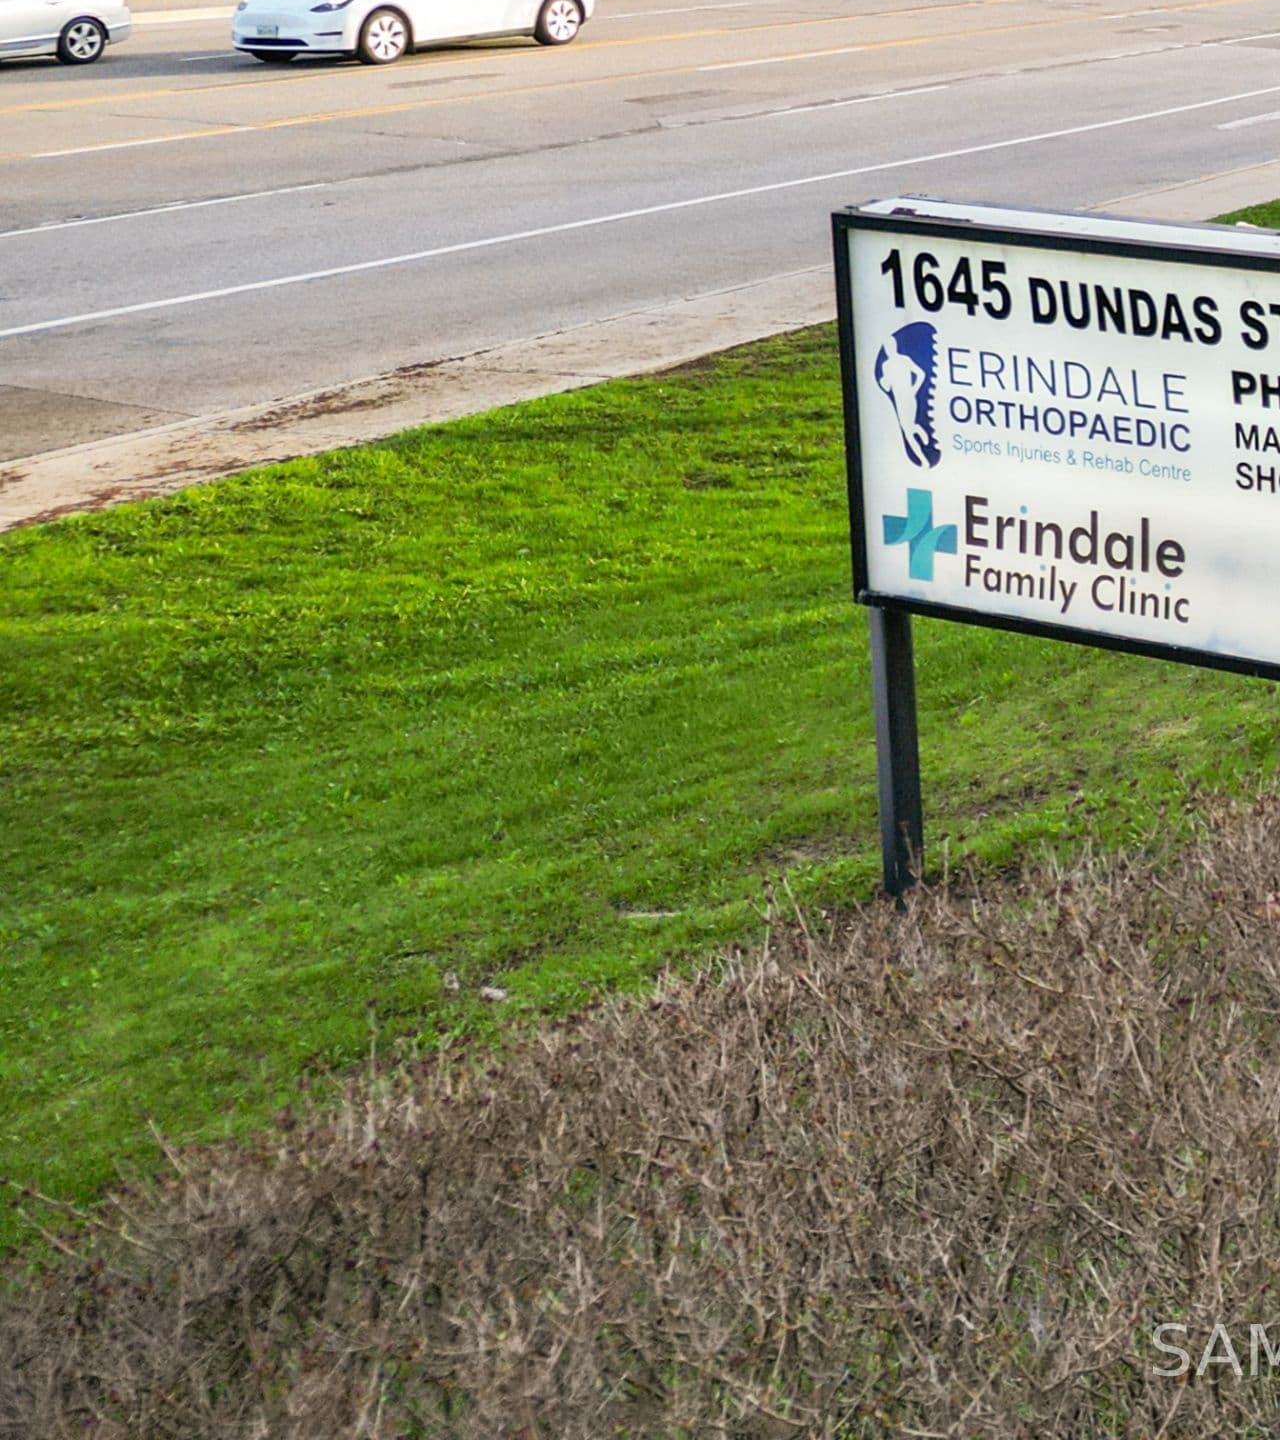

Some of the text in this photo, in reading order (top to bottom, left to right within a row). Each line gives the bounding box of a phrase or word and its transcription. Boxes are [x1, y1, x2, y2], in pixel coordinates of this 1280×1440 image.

[880, 248, 1013, 321] 1645
[1027, 276, 1224, 346] DUNDAS
[947, 346, 1191, 414] ERINDALE
[948, 395, 1193, 453] ORTHOPAEDIC
[951, 433, 1193, 483] Sports Injuries & Rehab Centre
[964, 494, 1187, 579] Erindale
[964, 554, 1191, 624] Family Clinic
